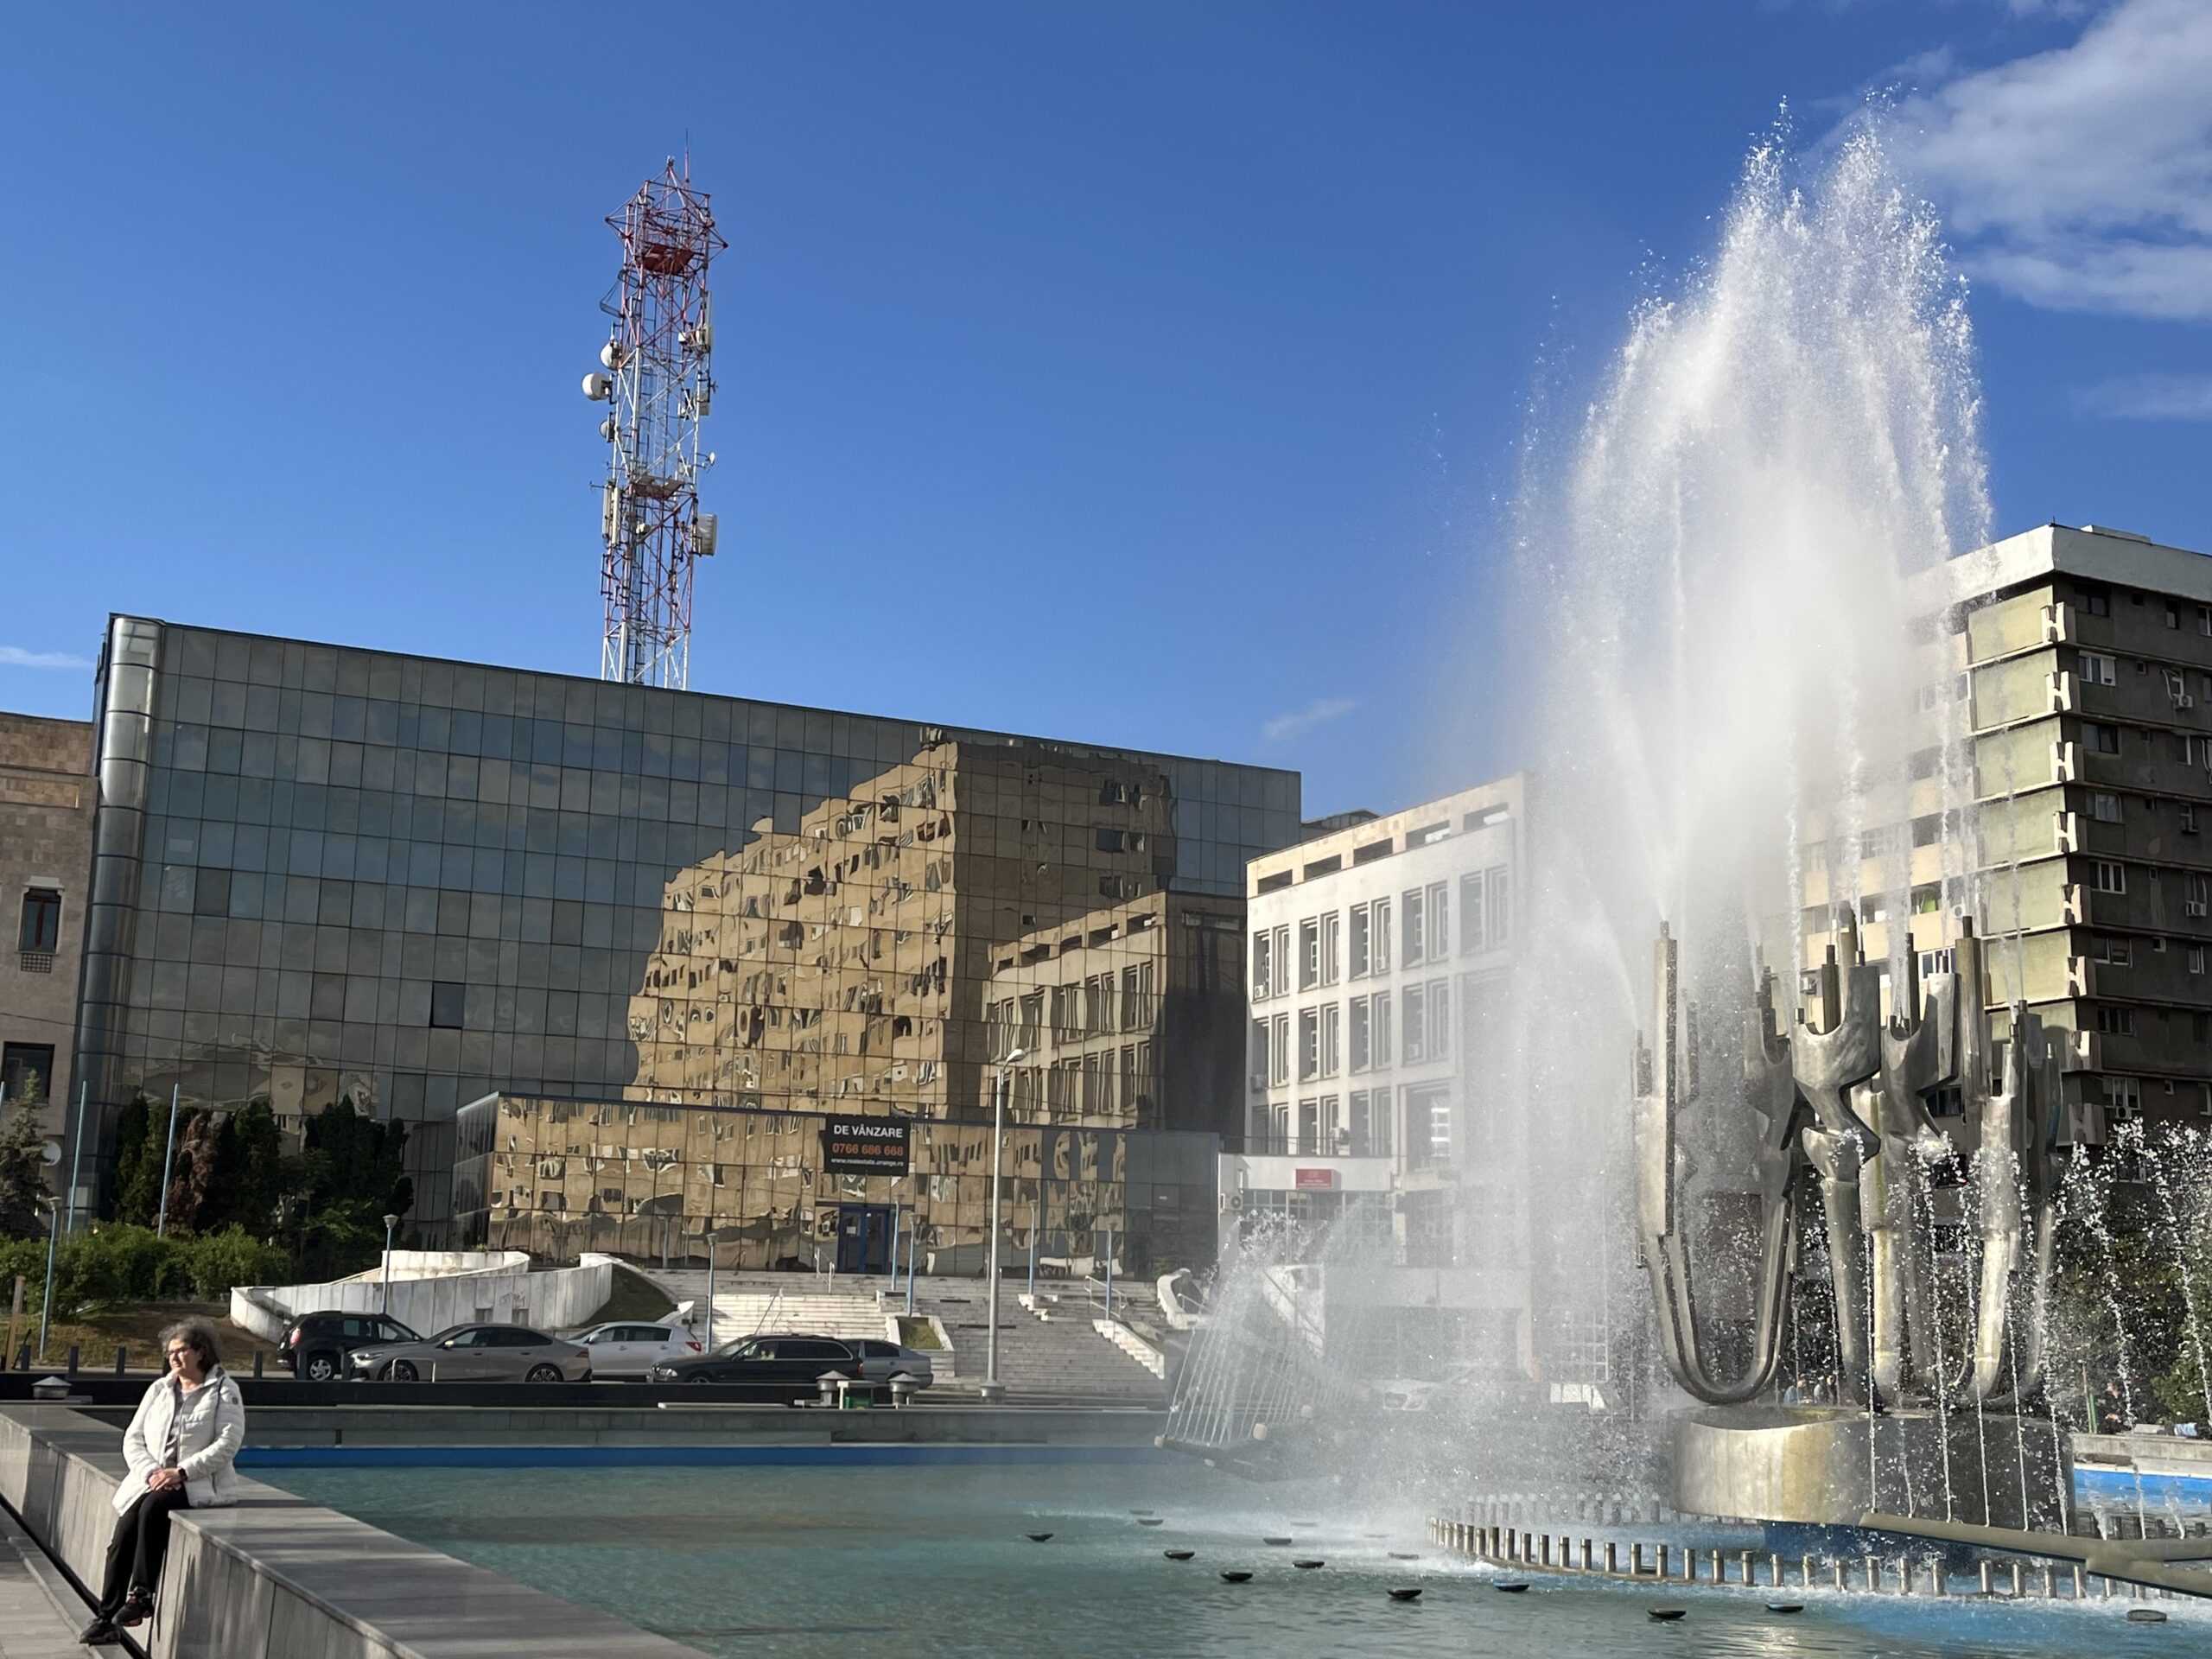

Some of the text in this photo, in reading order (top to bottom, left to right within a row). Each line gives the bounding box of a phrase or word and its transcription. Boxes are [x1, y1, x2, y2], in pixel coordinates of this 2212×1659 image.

[834, 1123, 903, 1138] DE VÂNZARE
[832, 1142, 859, 1154] 0766
